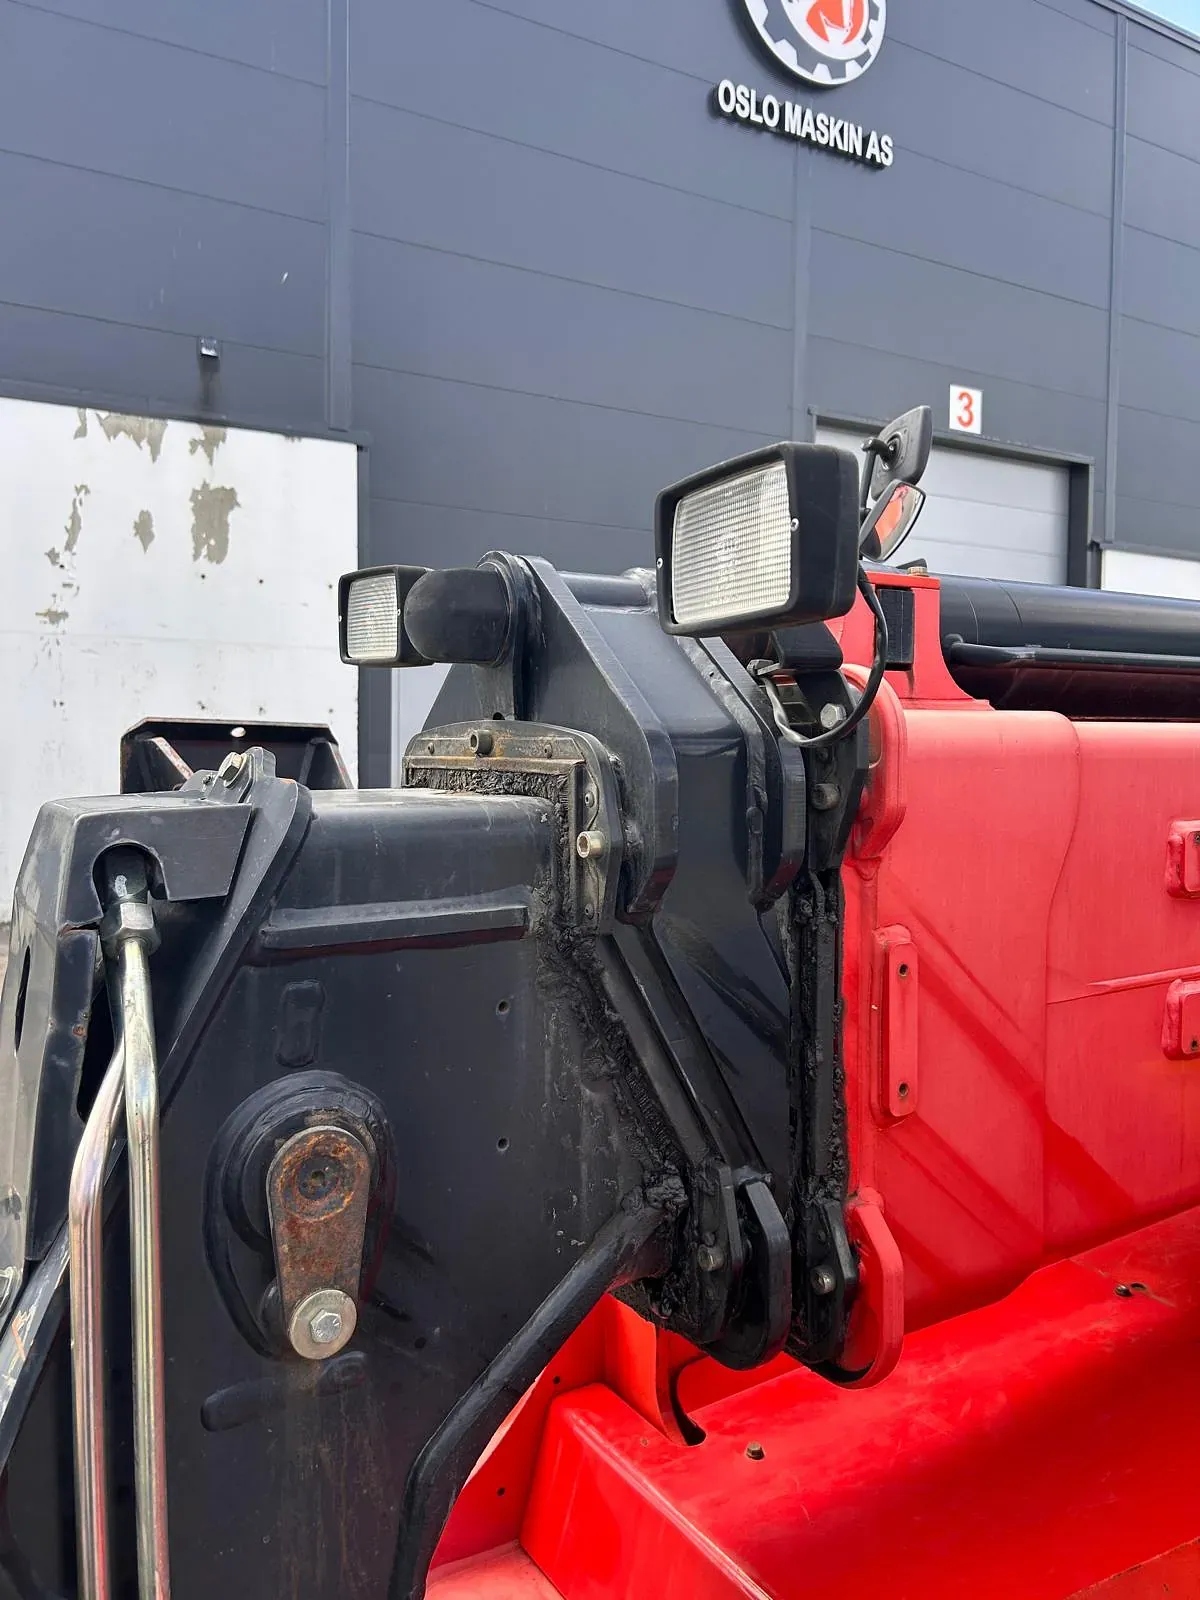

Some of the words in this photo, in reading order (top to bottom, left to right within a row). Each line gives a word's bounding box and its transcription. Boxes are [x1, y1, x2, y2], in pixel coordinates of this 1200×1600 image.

[718, 79, 780, 127] OSLO
[784, 101, 862, 156] MASKIN
[866, 130, 894, 166] AS
[957, 391, 974, 427] 3
